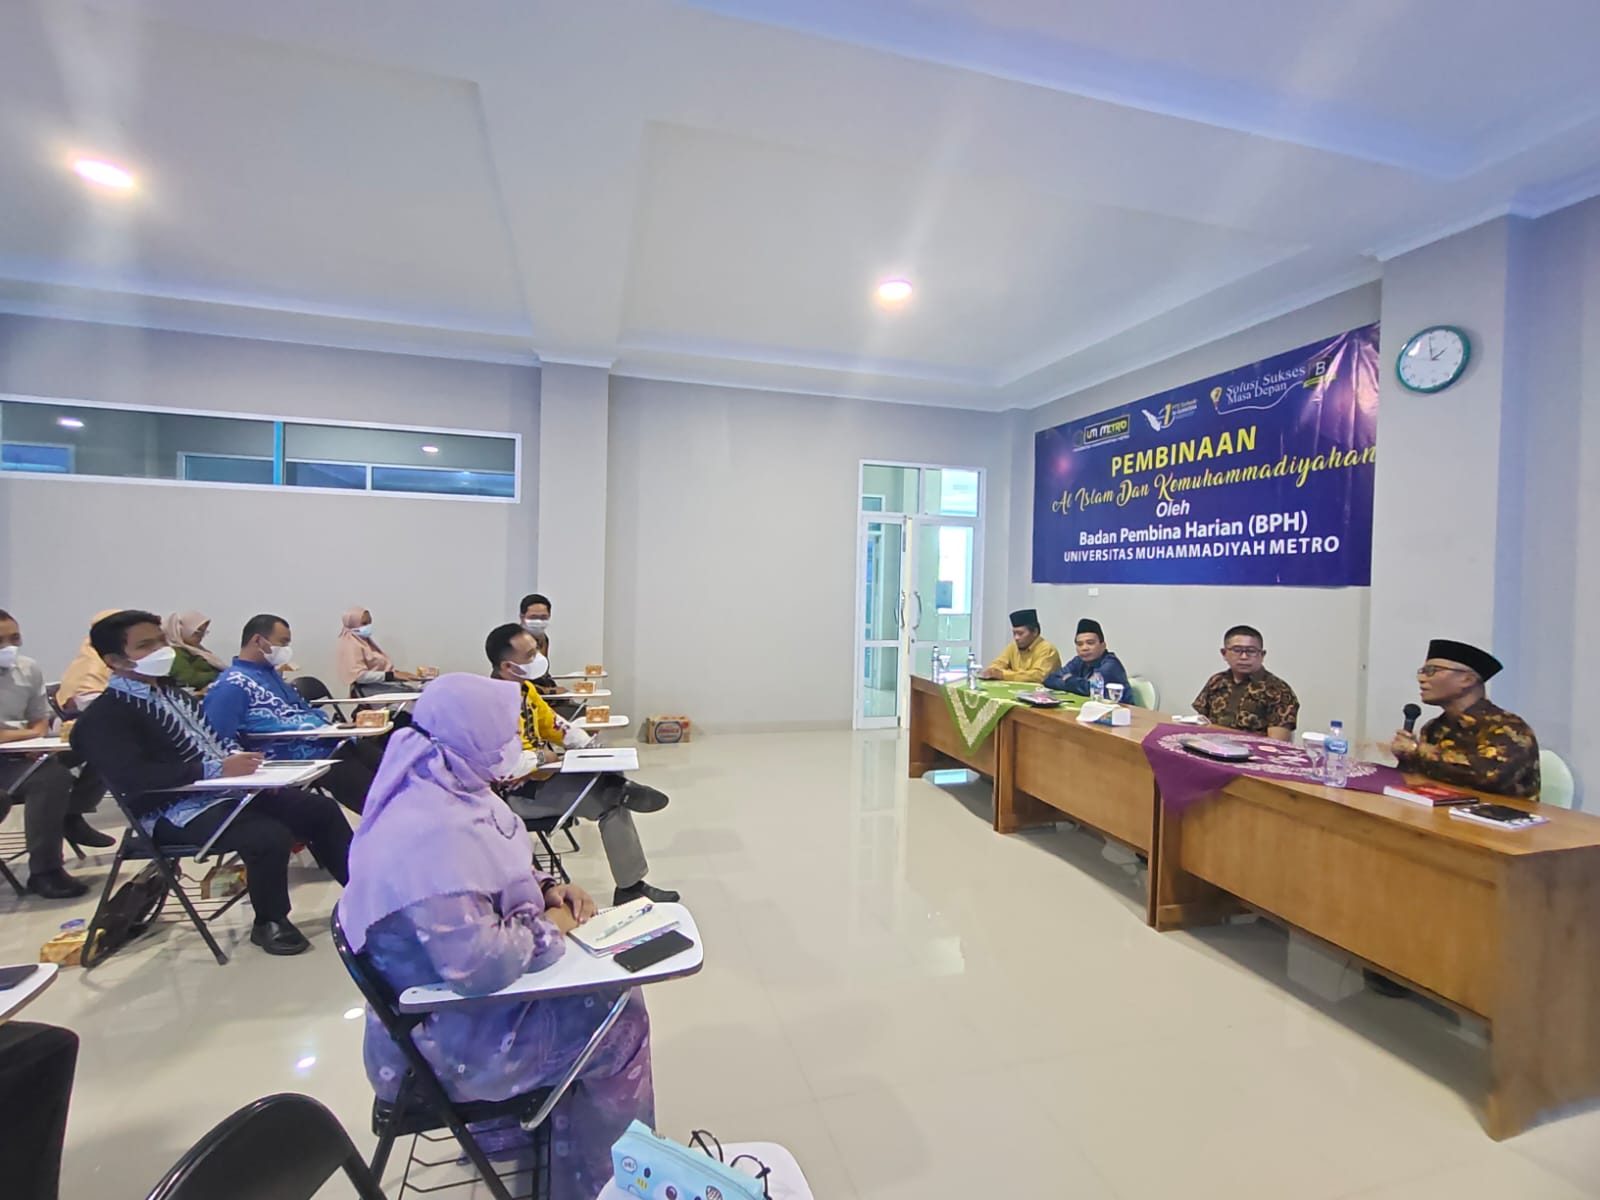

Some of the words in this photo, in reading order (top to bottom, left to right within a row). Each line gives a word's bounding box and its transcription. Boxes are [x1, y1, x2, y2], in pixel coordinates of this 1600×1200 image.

[1226, 378, 1259, 395] Solusi
[1262, 365, 1306, 386] Sukses
[1315, 361, 1326, 376] B
[1254, 381, 1287, 398] Depan
[1100, 420, 1128, 437] METRO
[1111, 425, 1257, 477] PEMBINAAN
[1052, 490, 1073, 515] Al
[1074, 487, 1114, 511] Islam
[1116, 479, 1150, 507] Dan
[1153, 445, 1377, 502] Kemuhammadiyahan
[1156, 499, 1190, 518] Oleh
[1079, 529, 1117, 546] Badan
[1120, 524, 1181, 543] Pembina
[1185, 518, 1243, 538] Harian
[1248, 510, 1308, 537] (BPH)
[1064, 548, 1134, 562] UNIVERSITAS
[1136, 540, 1265, 560] MUHAMMADIYAH
[1269, 535, 1340, 555] METRO
